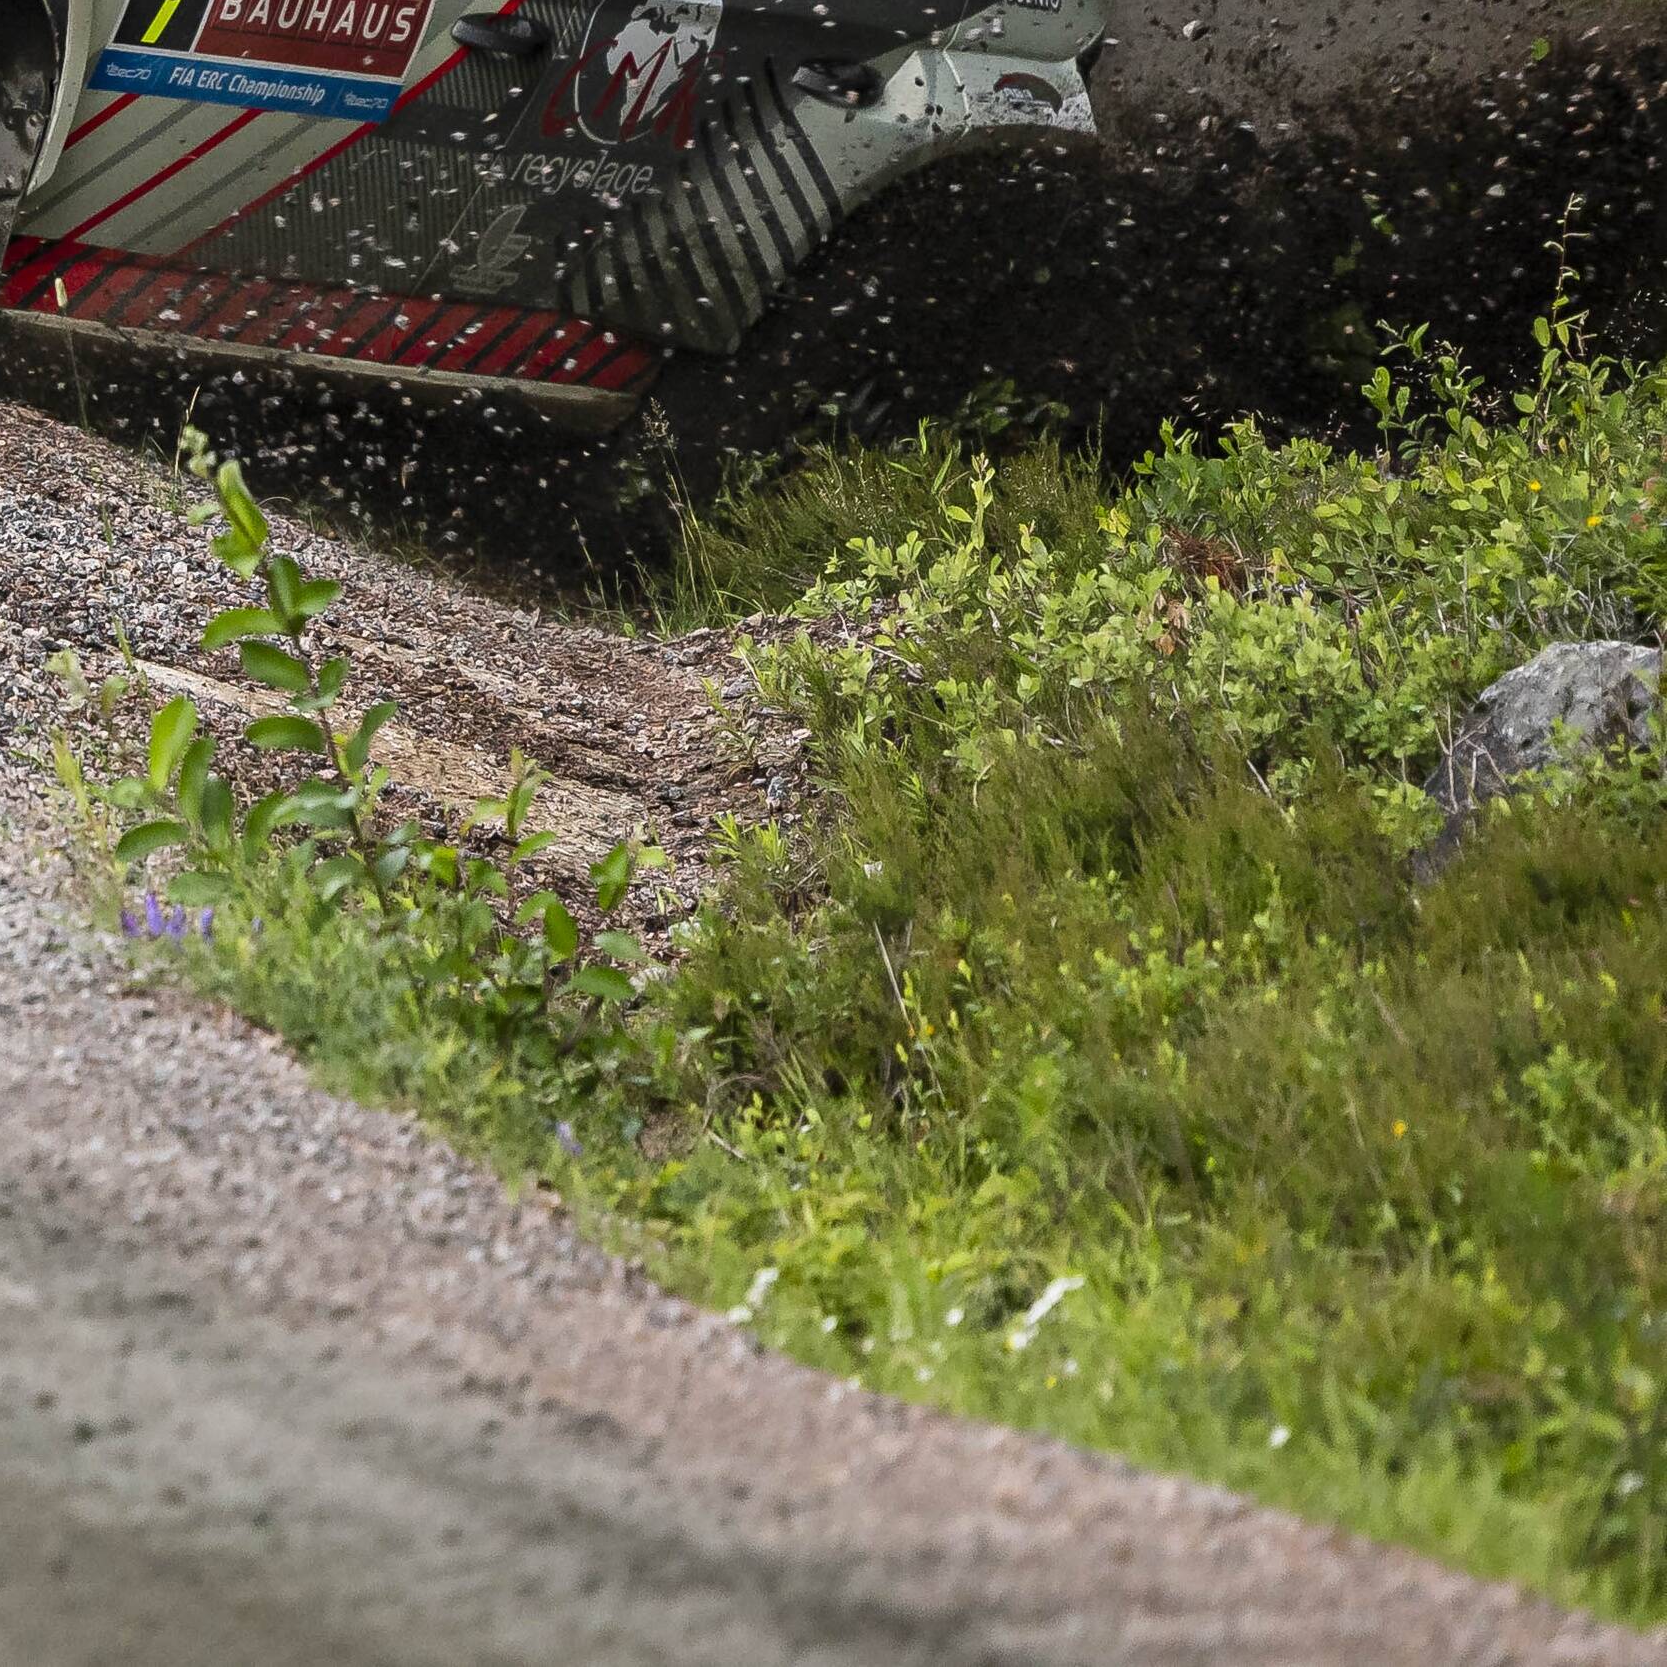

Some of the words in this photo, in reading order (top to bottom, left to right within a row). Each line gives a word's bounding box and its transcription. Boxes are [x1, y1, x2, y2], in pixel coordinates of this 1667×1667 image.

[169, 66, 193, 86] FIA
[196, 69, 224, 92] ERC
[227, 74, 326, 107] Championship
